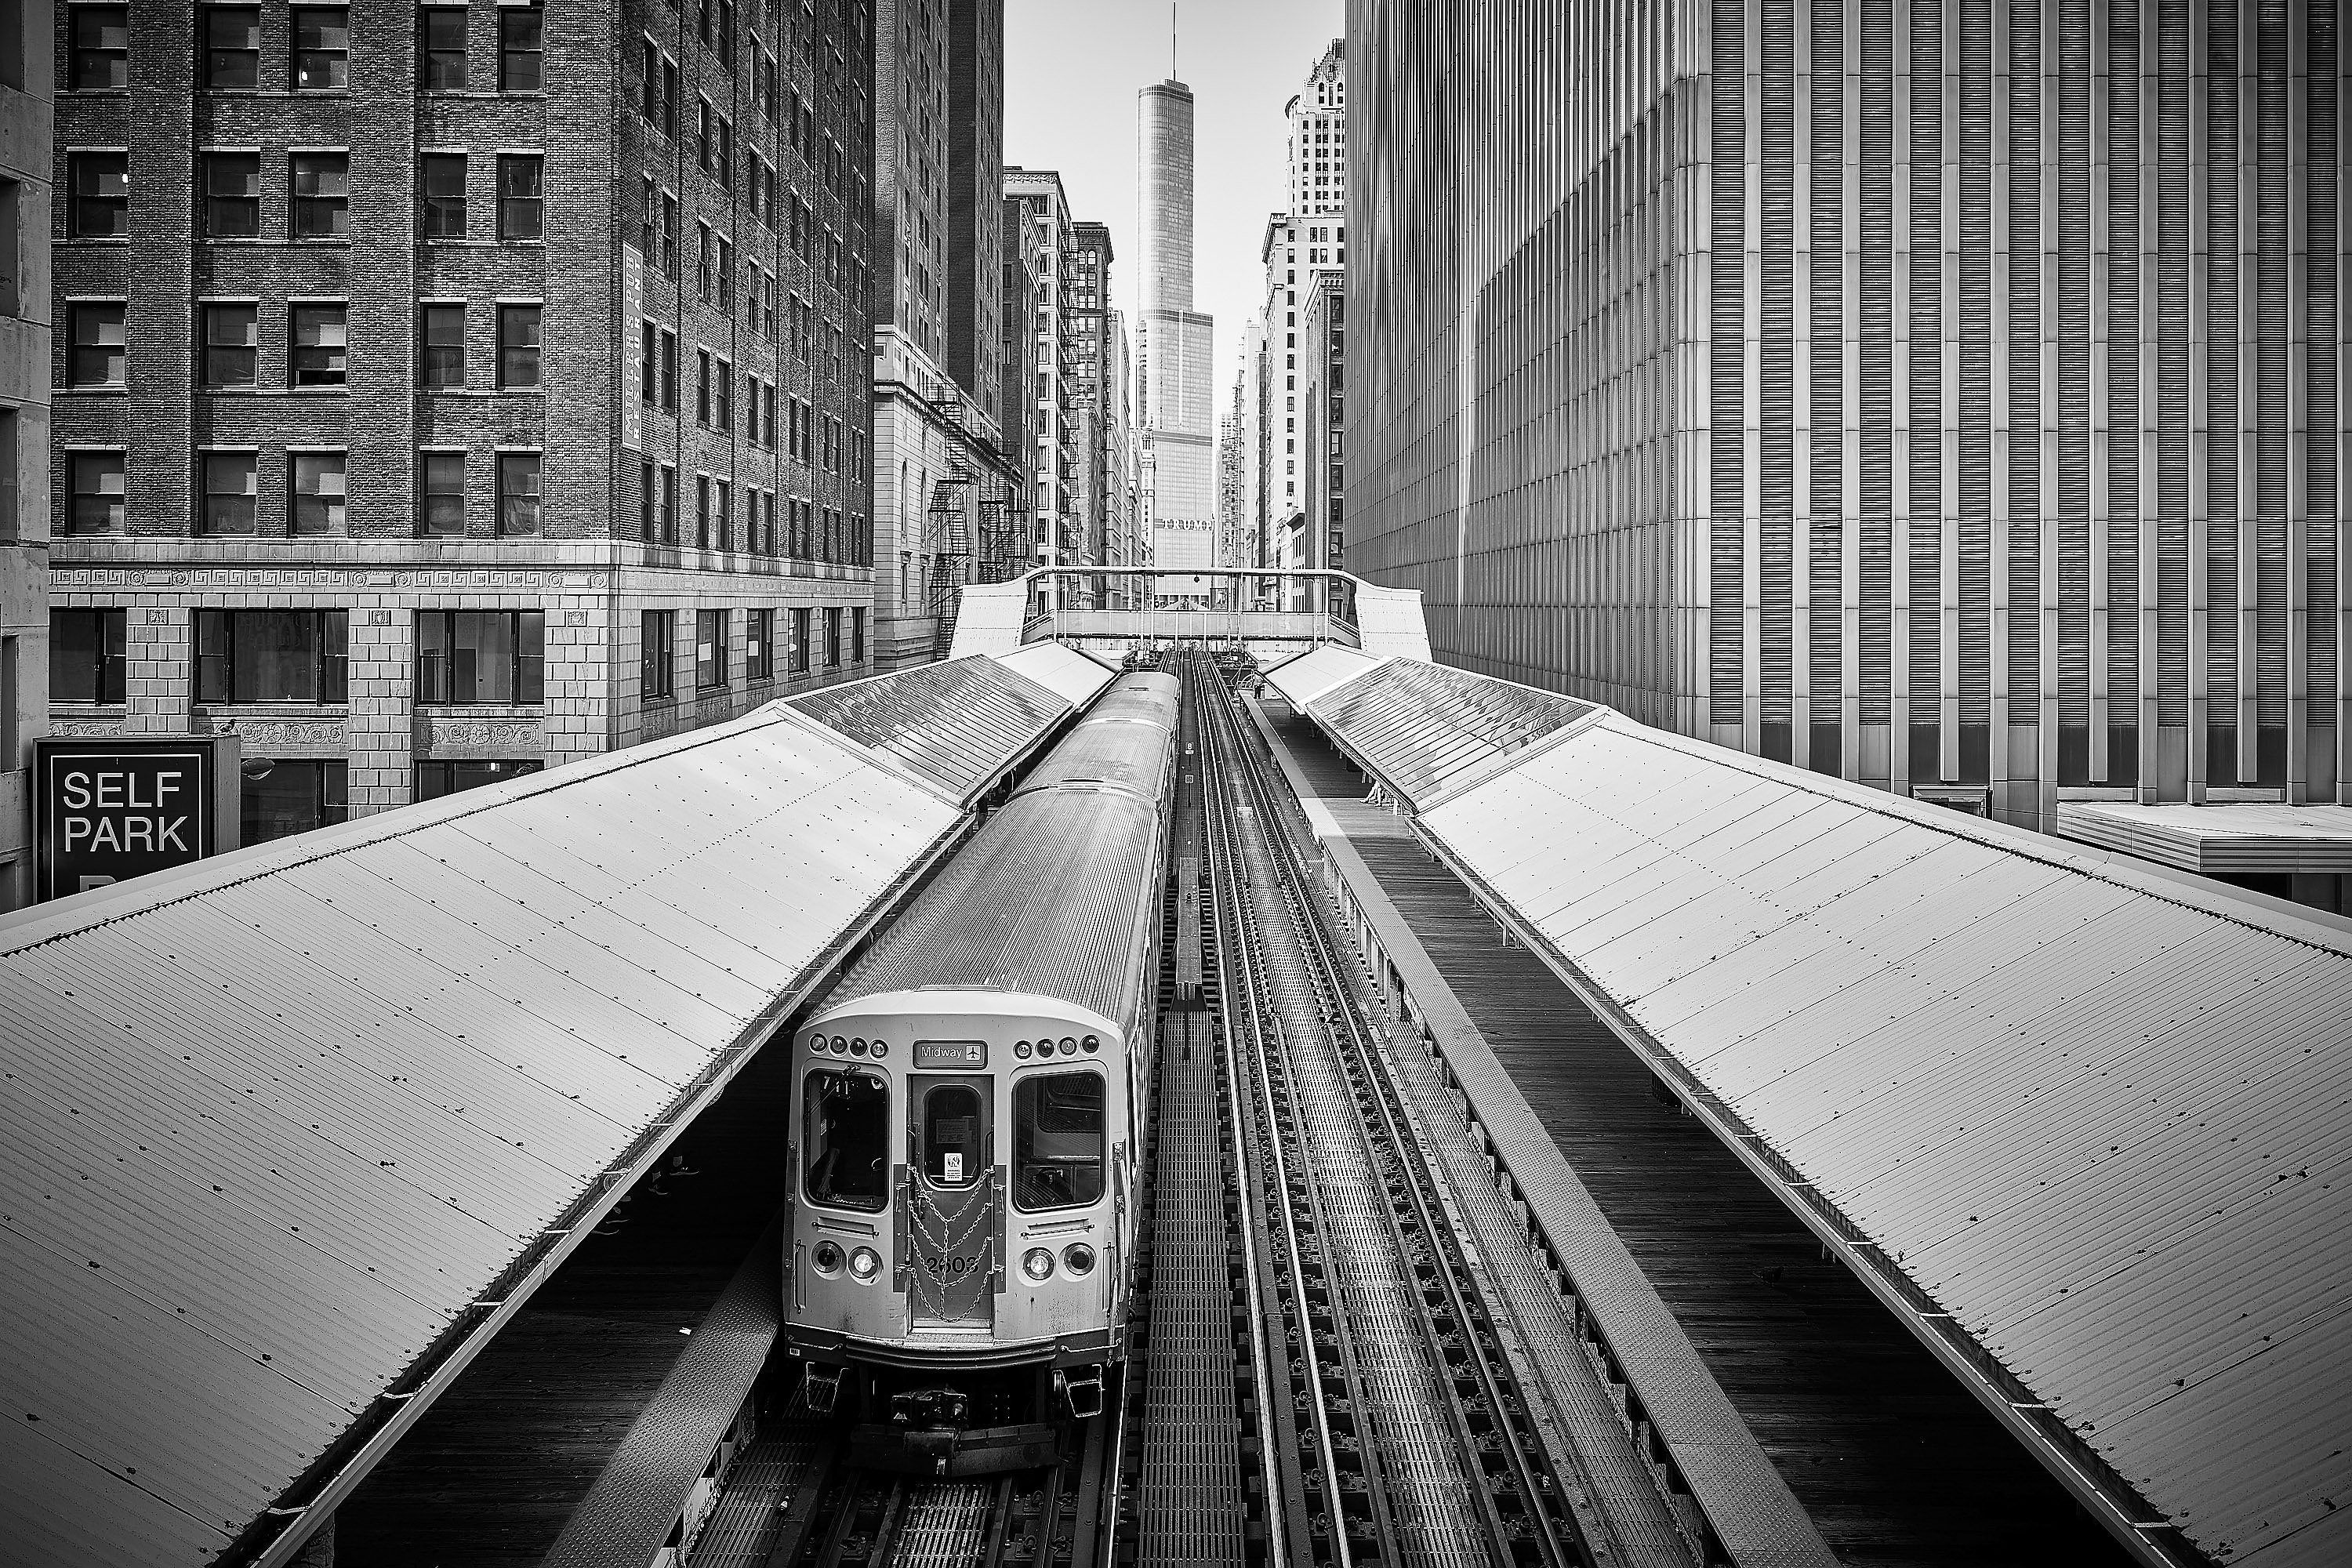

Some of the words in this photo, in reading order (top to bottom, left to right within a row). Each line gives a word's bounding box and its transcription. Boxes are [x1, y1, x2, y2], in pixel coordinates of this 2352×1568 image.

[626, 255, 635, 307] PUB
[625, 313, 635, 438] MILLER'S
[1163, 518, 1213, 531] TRUMP
[63, 771, 182, 808] SELF
[64, 816, 188, 852] PARK
[921, 1046, 963, 1059] Midway
[926, 1256, 979, 1274] 2603
